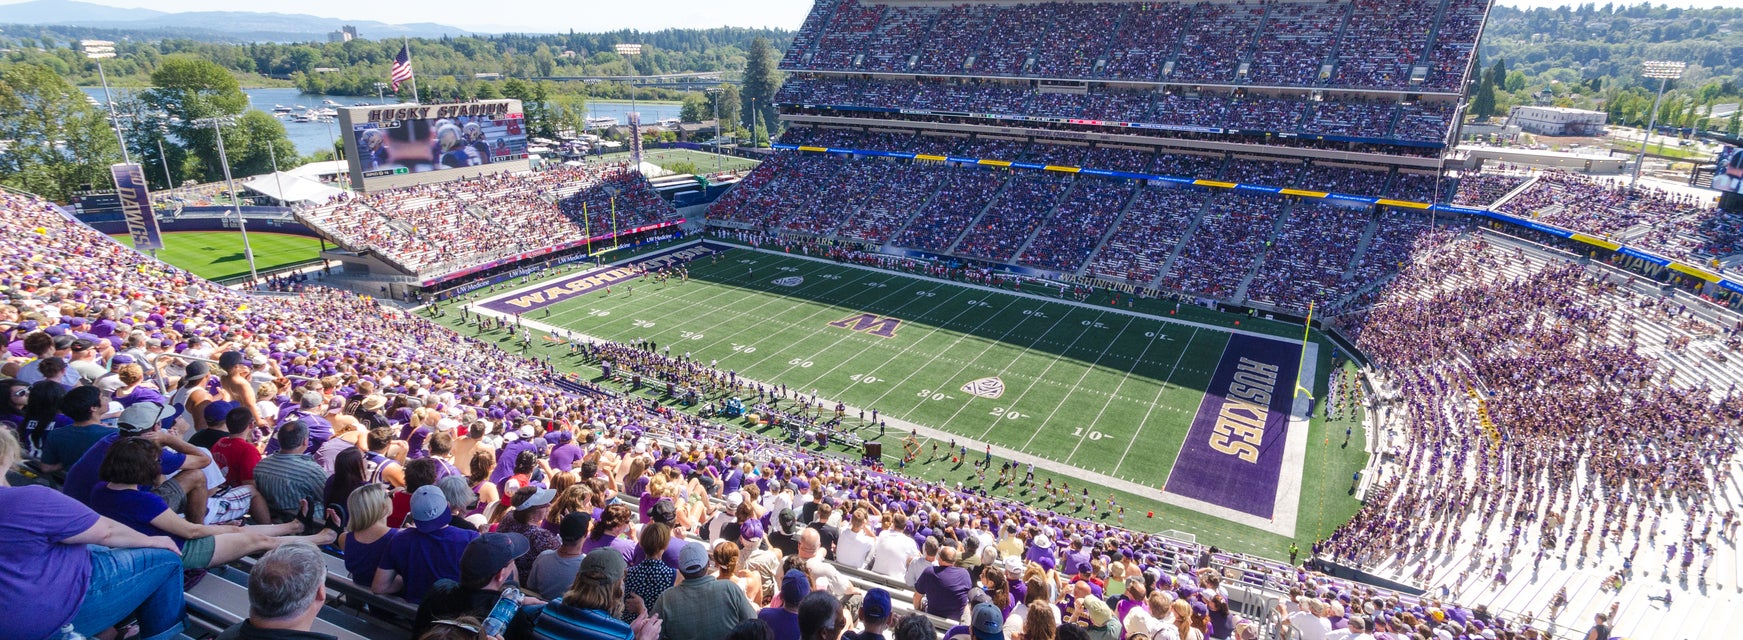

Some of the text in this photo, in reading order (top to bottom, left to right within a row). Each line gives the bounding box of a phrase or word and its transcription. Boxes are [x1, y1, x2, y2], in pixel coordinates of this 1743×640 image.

[368, 106, 431, 122] HUSKY
[437, 103, 509, 118] STADIUM
[119, 187, 151, 246] DAWGS
[468, 279, 490, 291] Medicine
[788, 357, 814, 368] 50
[849, 373, 877, 384] 40
[917, 389, 945, 401] 30
[988, 406, 1020, 420] 20
[1208, 356, 1279, 465] HUSKIES
[1070, 426, 1103, 441] 10
